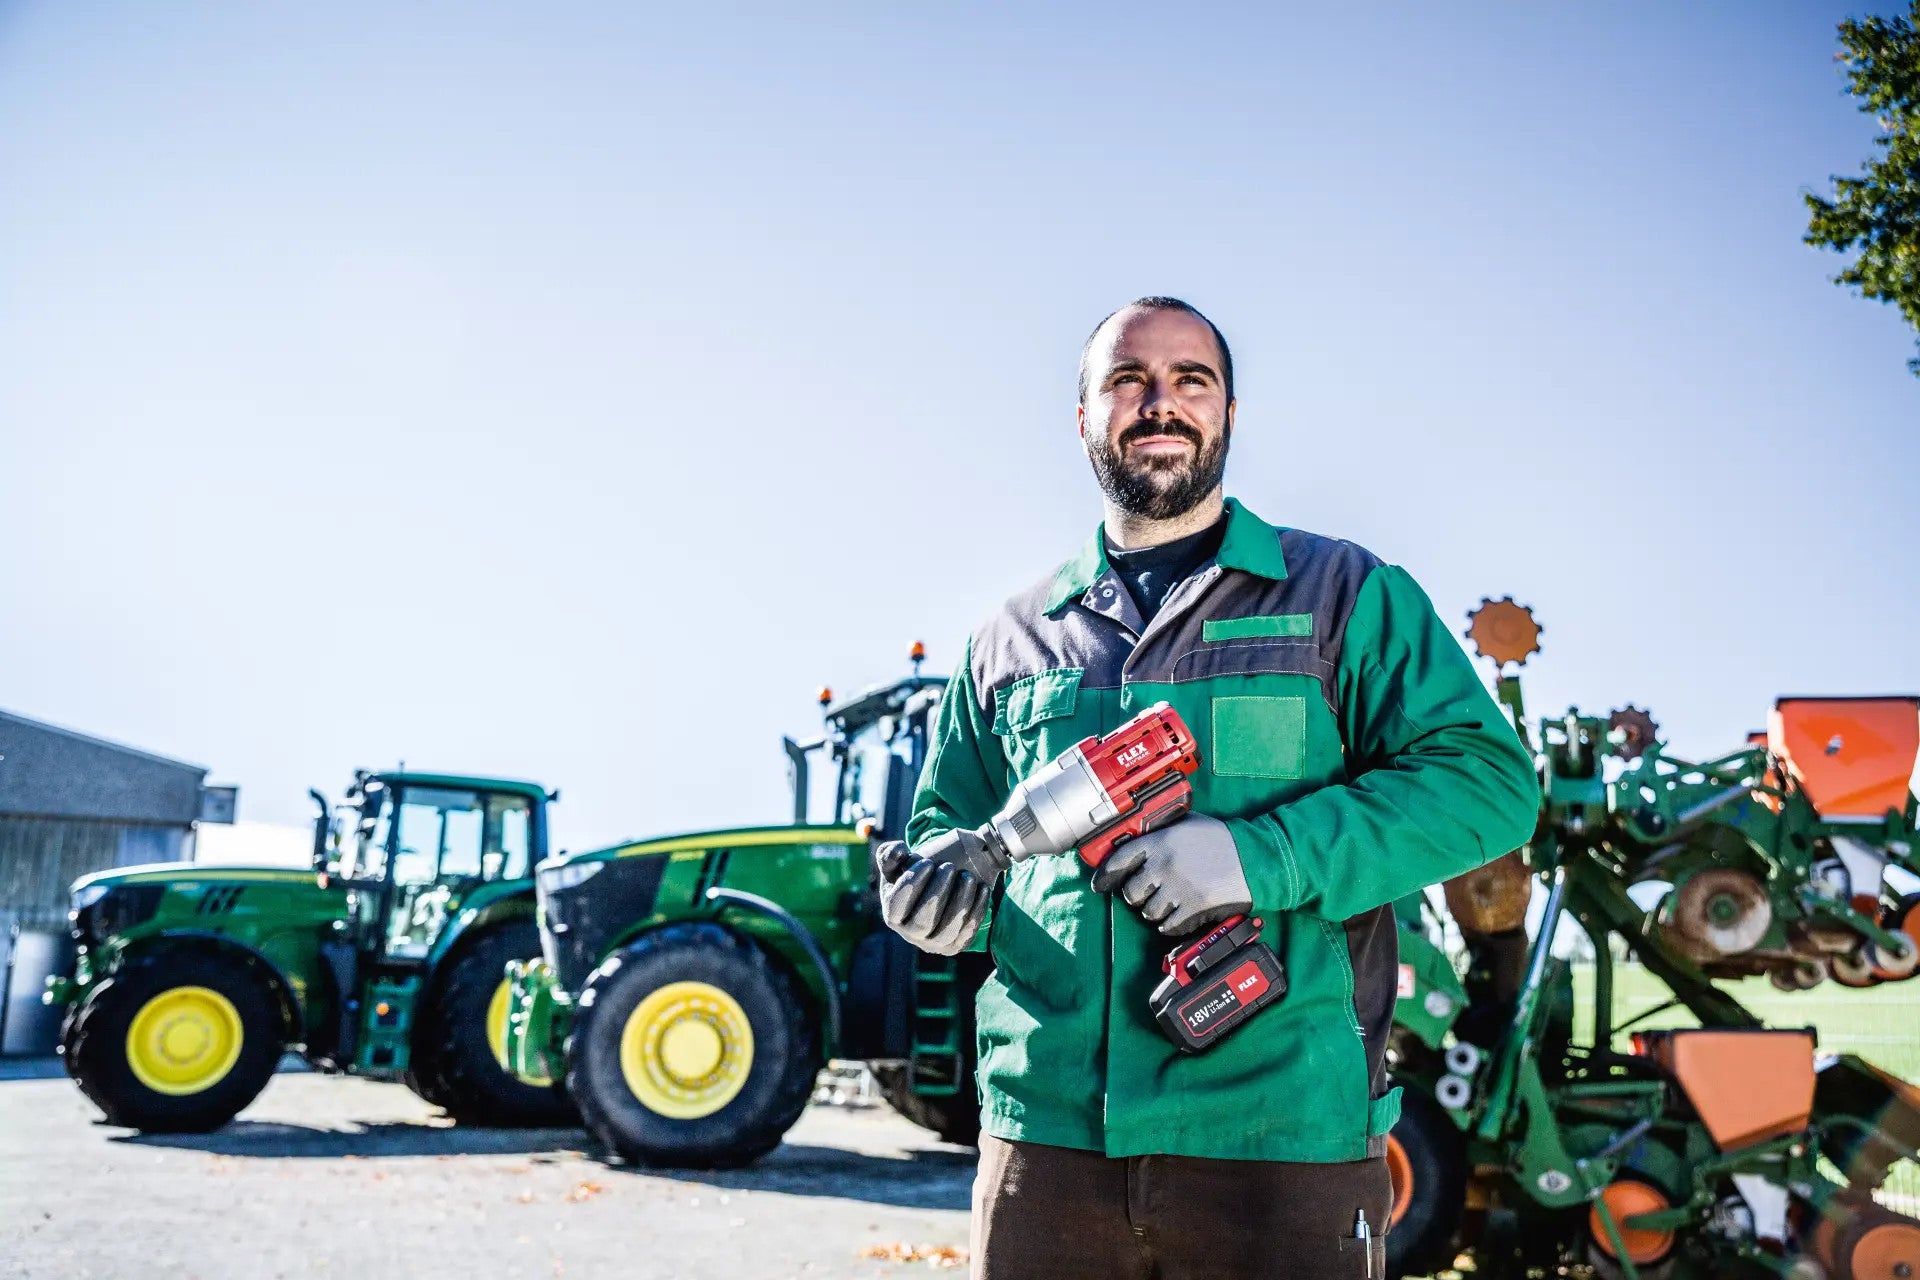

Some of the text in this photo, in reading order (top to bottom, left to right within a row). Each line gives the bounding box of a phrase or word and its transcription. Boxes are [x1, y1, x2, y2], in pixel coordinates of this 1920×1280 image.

[1116, 741, 1148, 766] FLEX
[1237, 974, 1258, 992] FLEX
[1188, 1005, 1210, 1027] 18V
